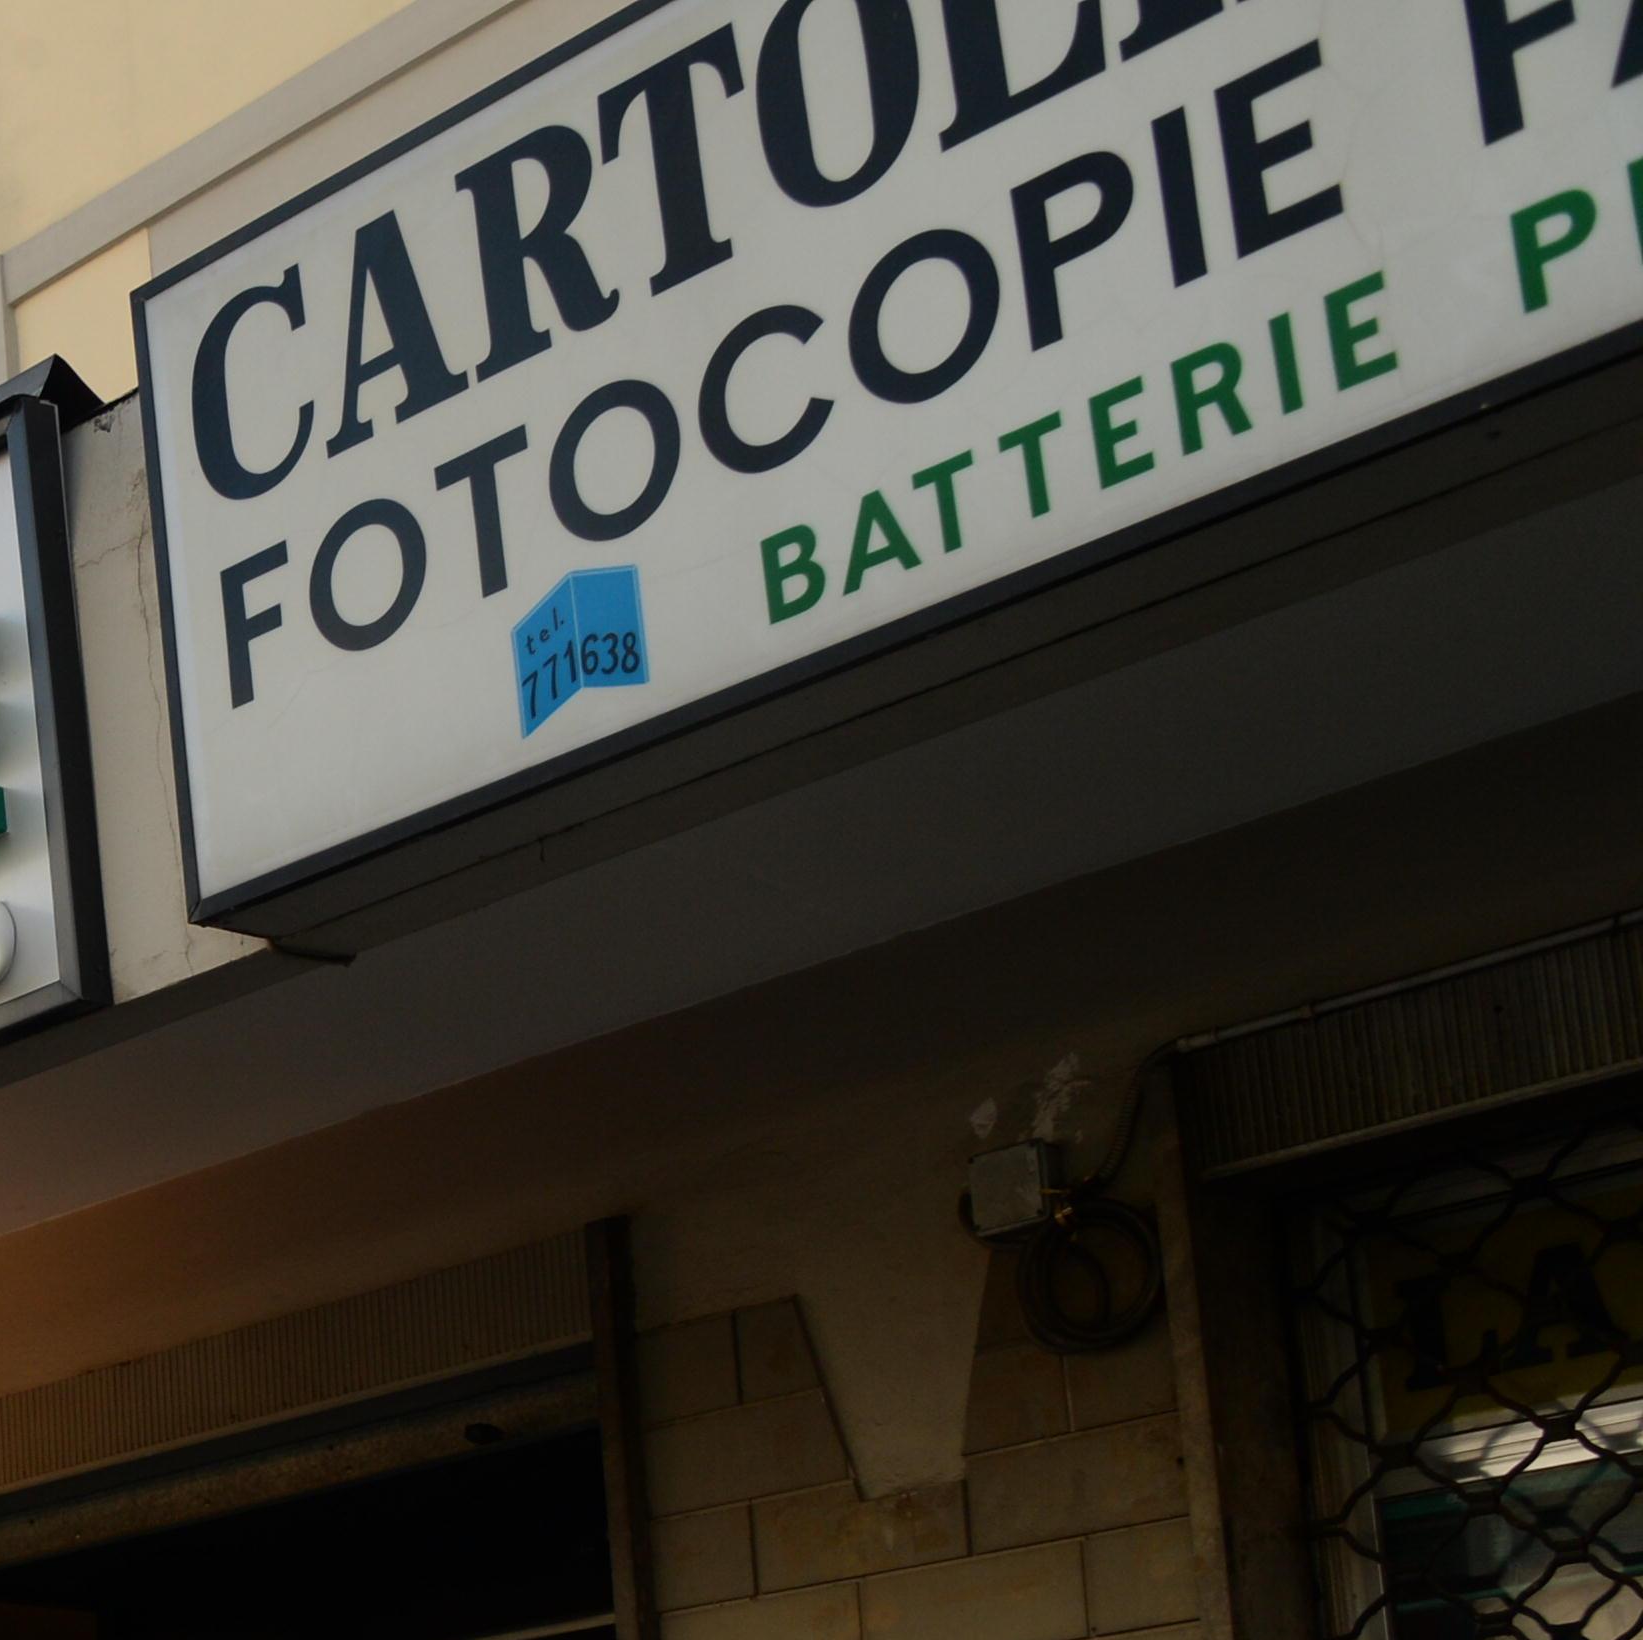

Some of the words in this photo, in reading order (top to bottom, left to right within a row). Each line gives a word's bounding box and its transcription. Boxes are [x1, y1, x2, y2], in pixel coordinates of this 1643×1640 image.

[191, 0, 1255, 500] CARTOL
[221, 40, 1343, 708] FOTOCOPIE
[1465, 0, 1643, 147] F
[761, 272, 1398, 625] BATTERIE
[520, 629, 645, 738] 771638
[522, 608, 566, 658] tel.
